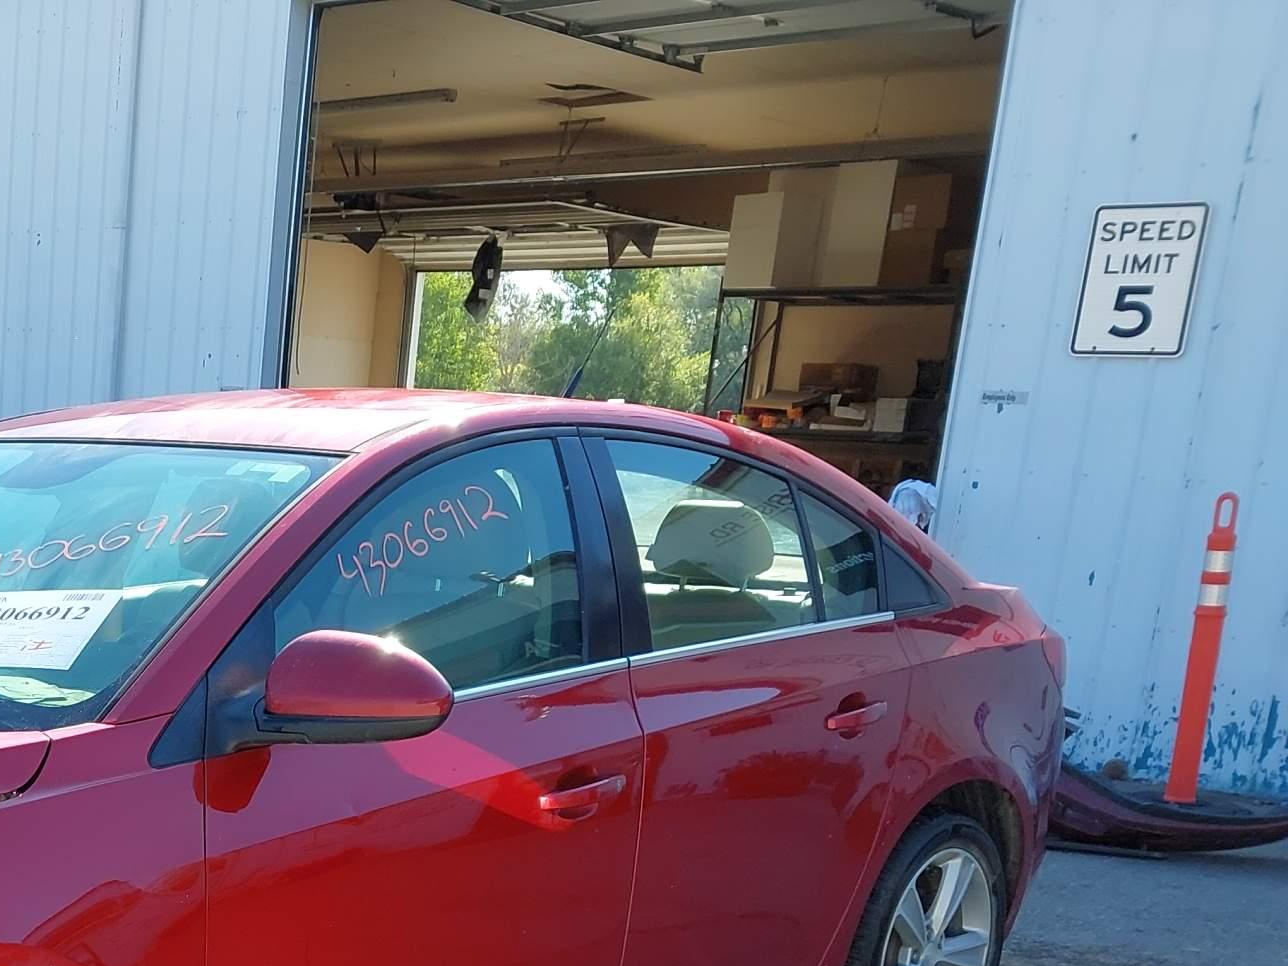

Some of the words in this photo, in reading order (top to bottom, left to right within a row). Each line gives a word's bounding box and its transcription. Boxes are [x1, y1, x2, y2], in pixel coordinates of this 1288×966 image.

[1100, 220, 1196, 242] SPEED
[1103, 253, 1180, 275] LIMIT
[1107, 285, 1155, 339] 5
[336, 485, 509, 596] 43066912
